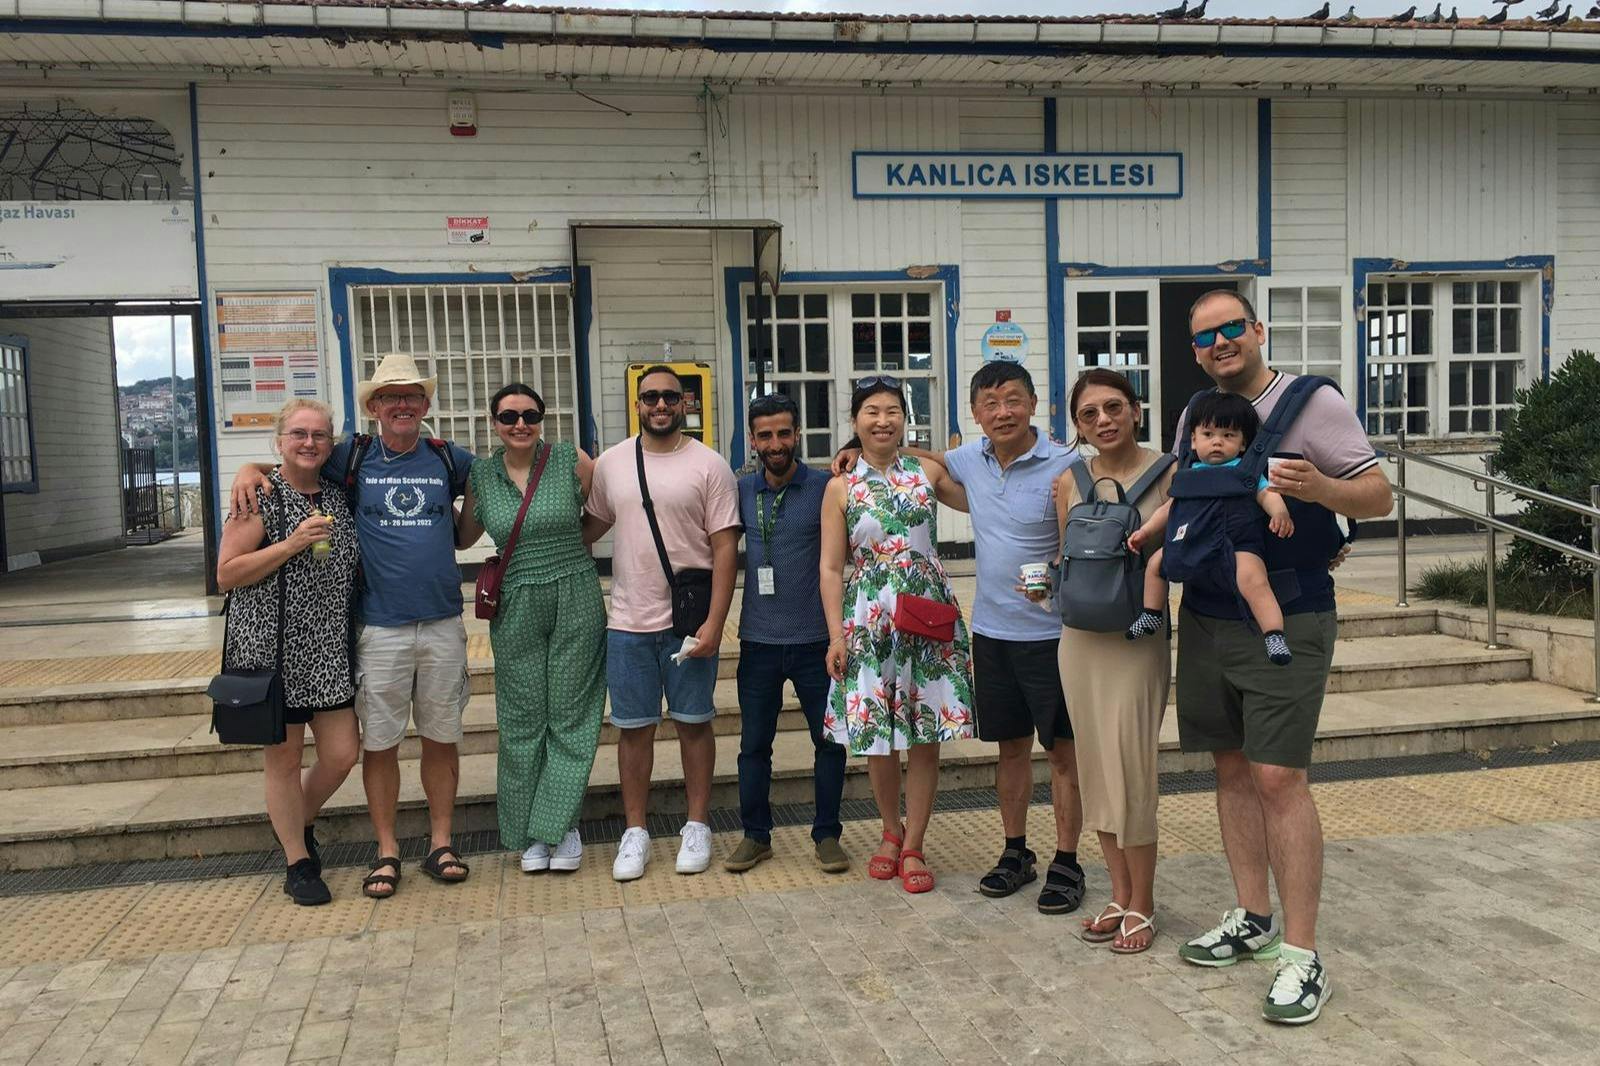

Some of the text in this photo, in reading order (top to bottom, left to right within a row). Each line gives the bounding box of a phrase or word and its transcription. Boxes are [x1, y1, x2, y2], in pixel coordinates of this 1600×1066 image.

[886, 163, 1154, 187] KANLICA ISKELESI
[24, 205, 75, 219] Havası
[401, 519, 416, 527] June
